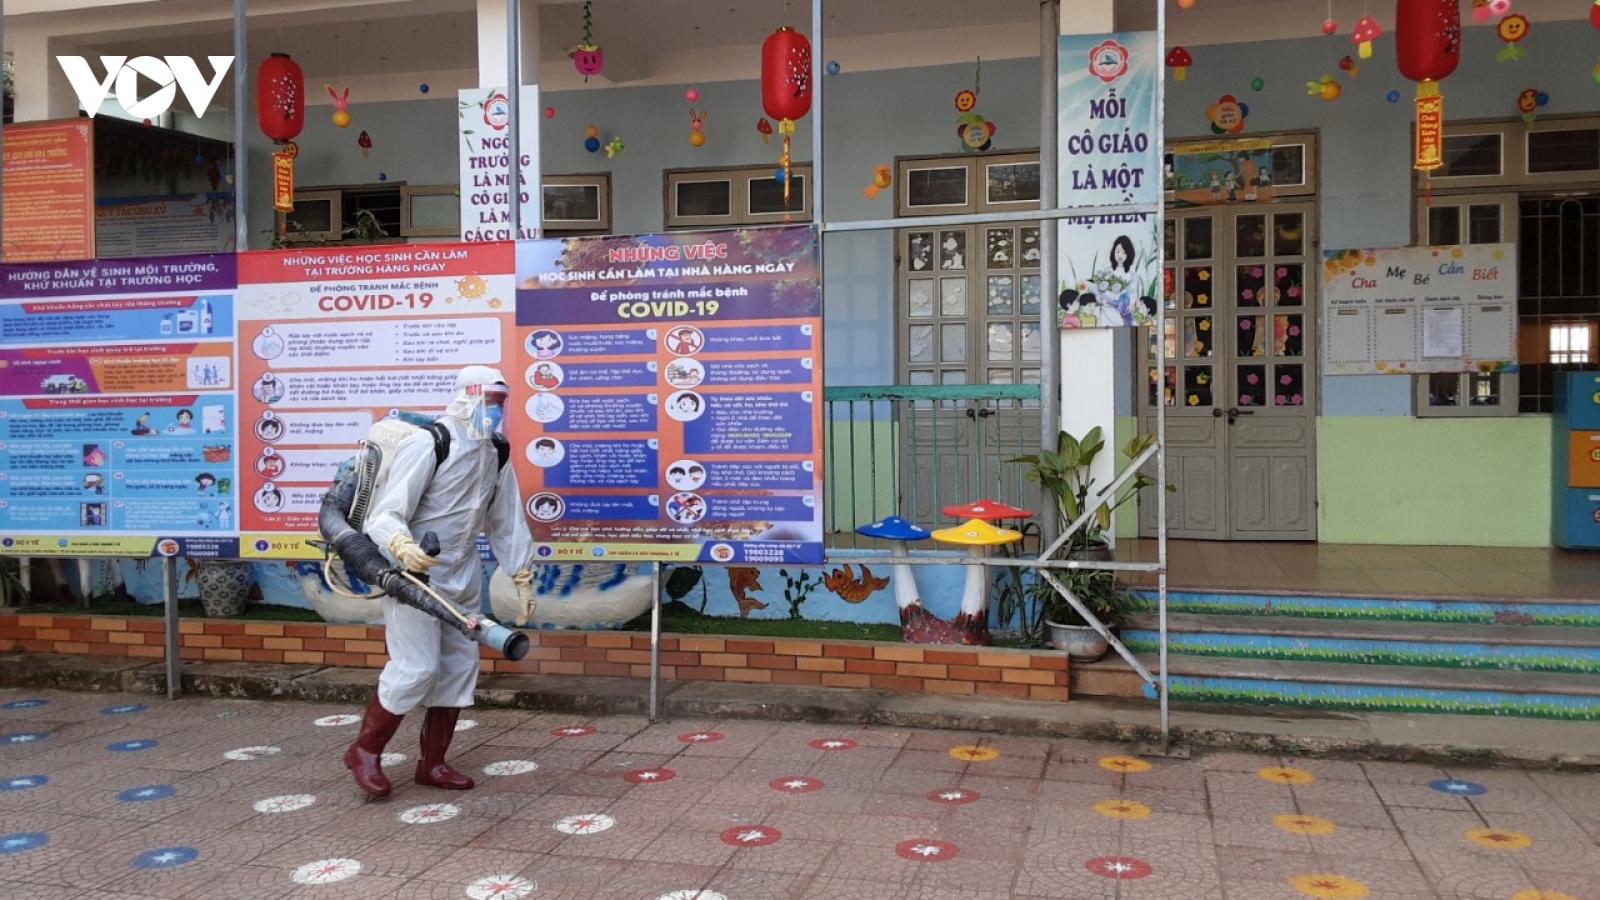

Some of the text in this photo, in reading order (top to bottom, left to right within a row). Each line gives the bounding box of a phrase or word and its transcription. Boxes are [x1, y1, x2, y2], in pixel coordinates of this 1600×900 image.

[1090, 87, 1126, 118] MỖI
[481, 134, 511, 150] NGÔ
[1068, 127, 1148, 155] CÔ GIÁO
[469, 152, 530, 168] TRƯỜG
[474, 172, 491, 187] LÀ
[1072, 162, 1144, 193] LÀ MỘT
[471, 190, 529, 205] CÔ GIO
[480, 208, 497, 223] LÀ
[465, 226, 494, 242] CÁC
[283, 249, 468, 266] NHỮNG VIỆC HỌC SINH CẦN LÀM
[609, 240, 727, 263] NHỮNG VIỆC
[9, 270, 50, 281] HƯỚNG
[55, 268, 79, 279] DẪN
[83, 266, 98, 278] VỆ
[102, 267, 130, 276] SINH
[135, 264, 158, 275] MÔI
[304, 263, 446, 278] TẠI TRƯỜNG HÀNG NGÀY
[539, 261, 795, 282] HỌC SINH CẦN LÀM TẠI NHÀ HÀNG NGÀY
[1351, 261, 1499, 288] Cha Mẹ Bé Cần Biết
[24, 274, 202, 290] KHỬ KHUẨN TẠI TRƯỜNG HỌC
[310, 281, 438, 293] ĐỂ PHÒNG TRÁNH MẮC BỆNH
[590, 286, 748, 302] Để phòng tránh mắc bệnh
[318, 293, 434, 312] COVID-19
[617, 300, 720, 318] COVID-19
[271, 543, 281, 551] BỘ
[289, 541, 299, 549] TẾ
[575, 546, 583, 554] TẾ
